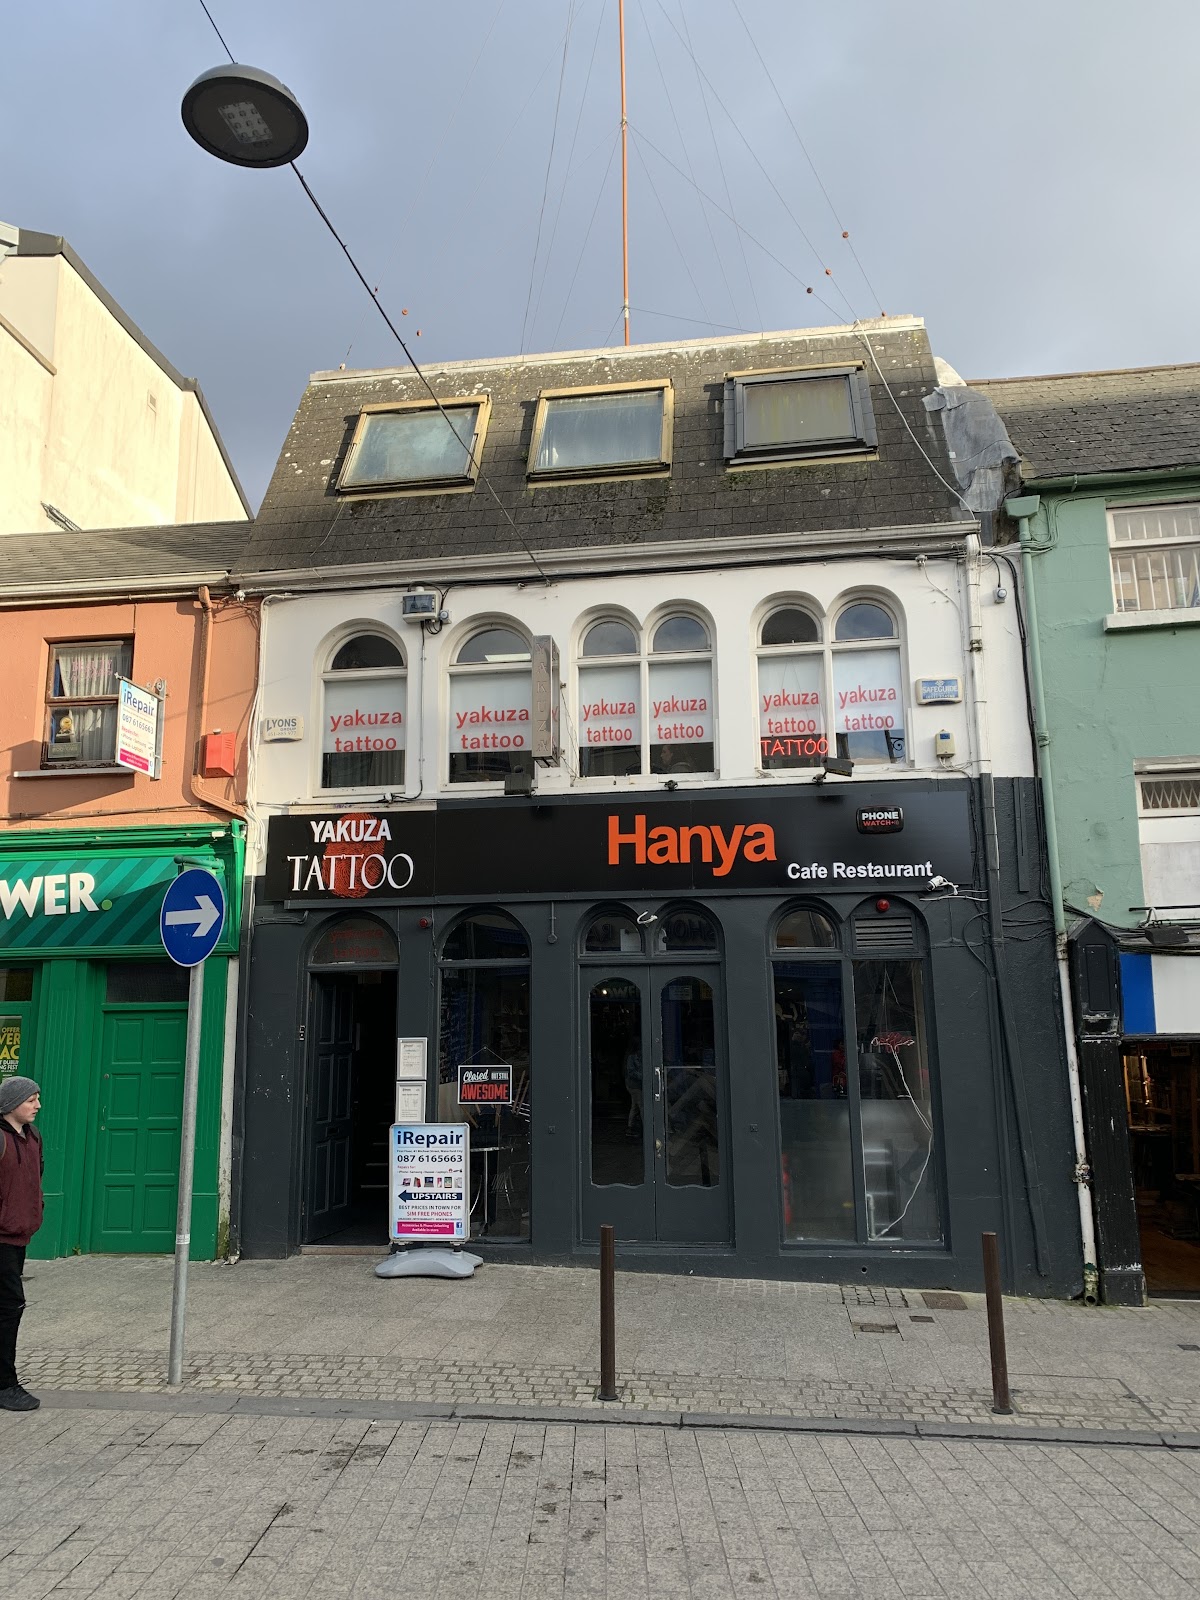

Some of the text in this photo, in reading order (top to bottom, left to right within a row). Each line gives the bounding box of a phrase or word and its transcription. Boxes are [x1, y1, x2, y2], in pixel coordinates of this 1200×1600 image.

[838, 685, 896, 709] yakuza
[922, 685, 958, 693] SAFEGUIDE
[123, 689, 155, 716] iRepair
[583, 698, 636, 721] yakuza
[653, 695, 707, 718] yakuza
[763, 689, 819, 712] yakuza
[266, 718, 297, 731] LYONS
[330, 709, 402, 732] yakuza
[456, 706, 529, 729] yakuza
[767, 717, 816, 734] tattoo
[844, 713, 894, 731] tattoo
[587, 726, 632, 742] tattoo
[657, 723, 704, 739] tattoo
[334, 736, 397, 752] tattoo
[461, 733, 525, 749] tattoo
[760, 737, 829, 756] TATTOO
[861, 811, 899, 820] PHONE
[310, 819, 392, 843] YAKUZA
[608, 814, 778, 877] Hanya
[287, 853, 414, 891] TATTOO
[787, 860, 933, 880] Cafe Restaurant
[463, 1069, 489, 1084] Closed
[461, 1083, 509, 1100] AWESOME
[397, 1131, 463, 1148] iRepair
[397, 1154, 463, 1163] 087 6165663
